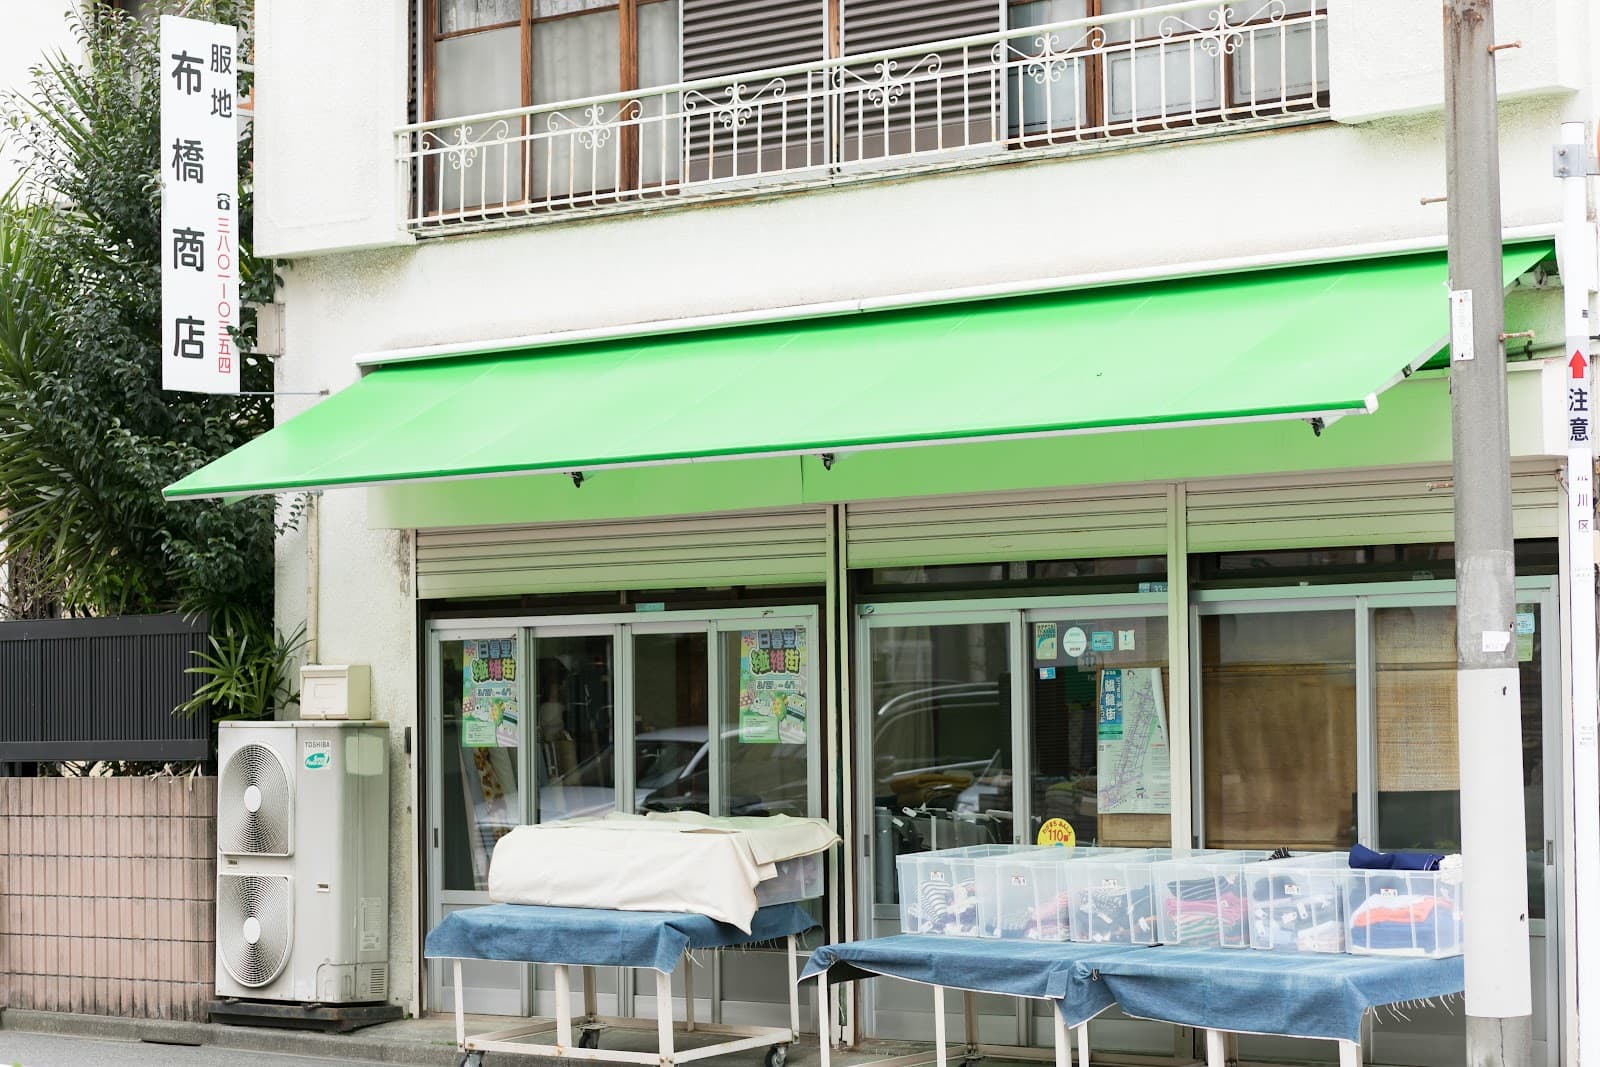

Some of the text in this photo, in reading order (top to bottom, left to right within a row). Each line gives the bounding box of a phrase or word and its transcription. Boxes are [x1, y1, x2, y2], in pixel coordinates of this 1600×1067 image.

[210, 43, 233, 119] 服地
[171, 49, 206, 360] 布橋商店
[1568, 387, 1589, 442] 注意
